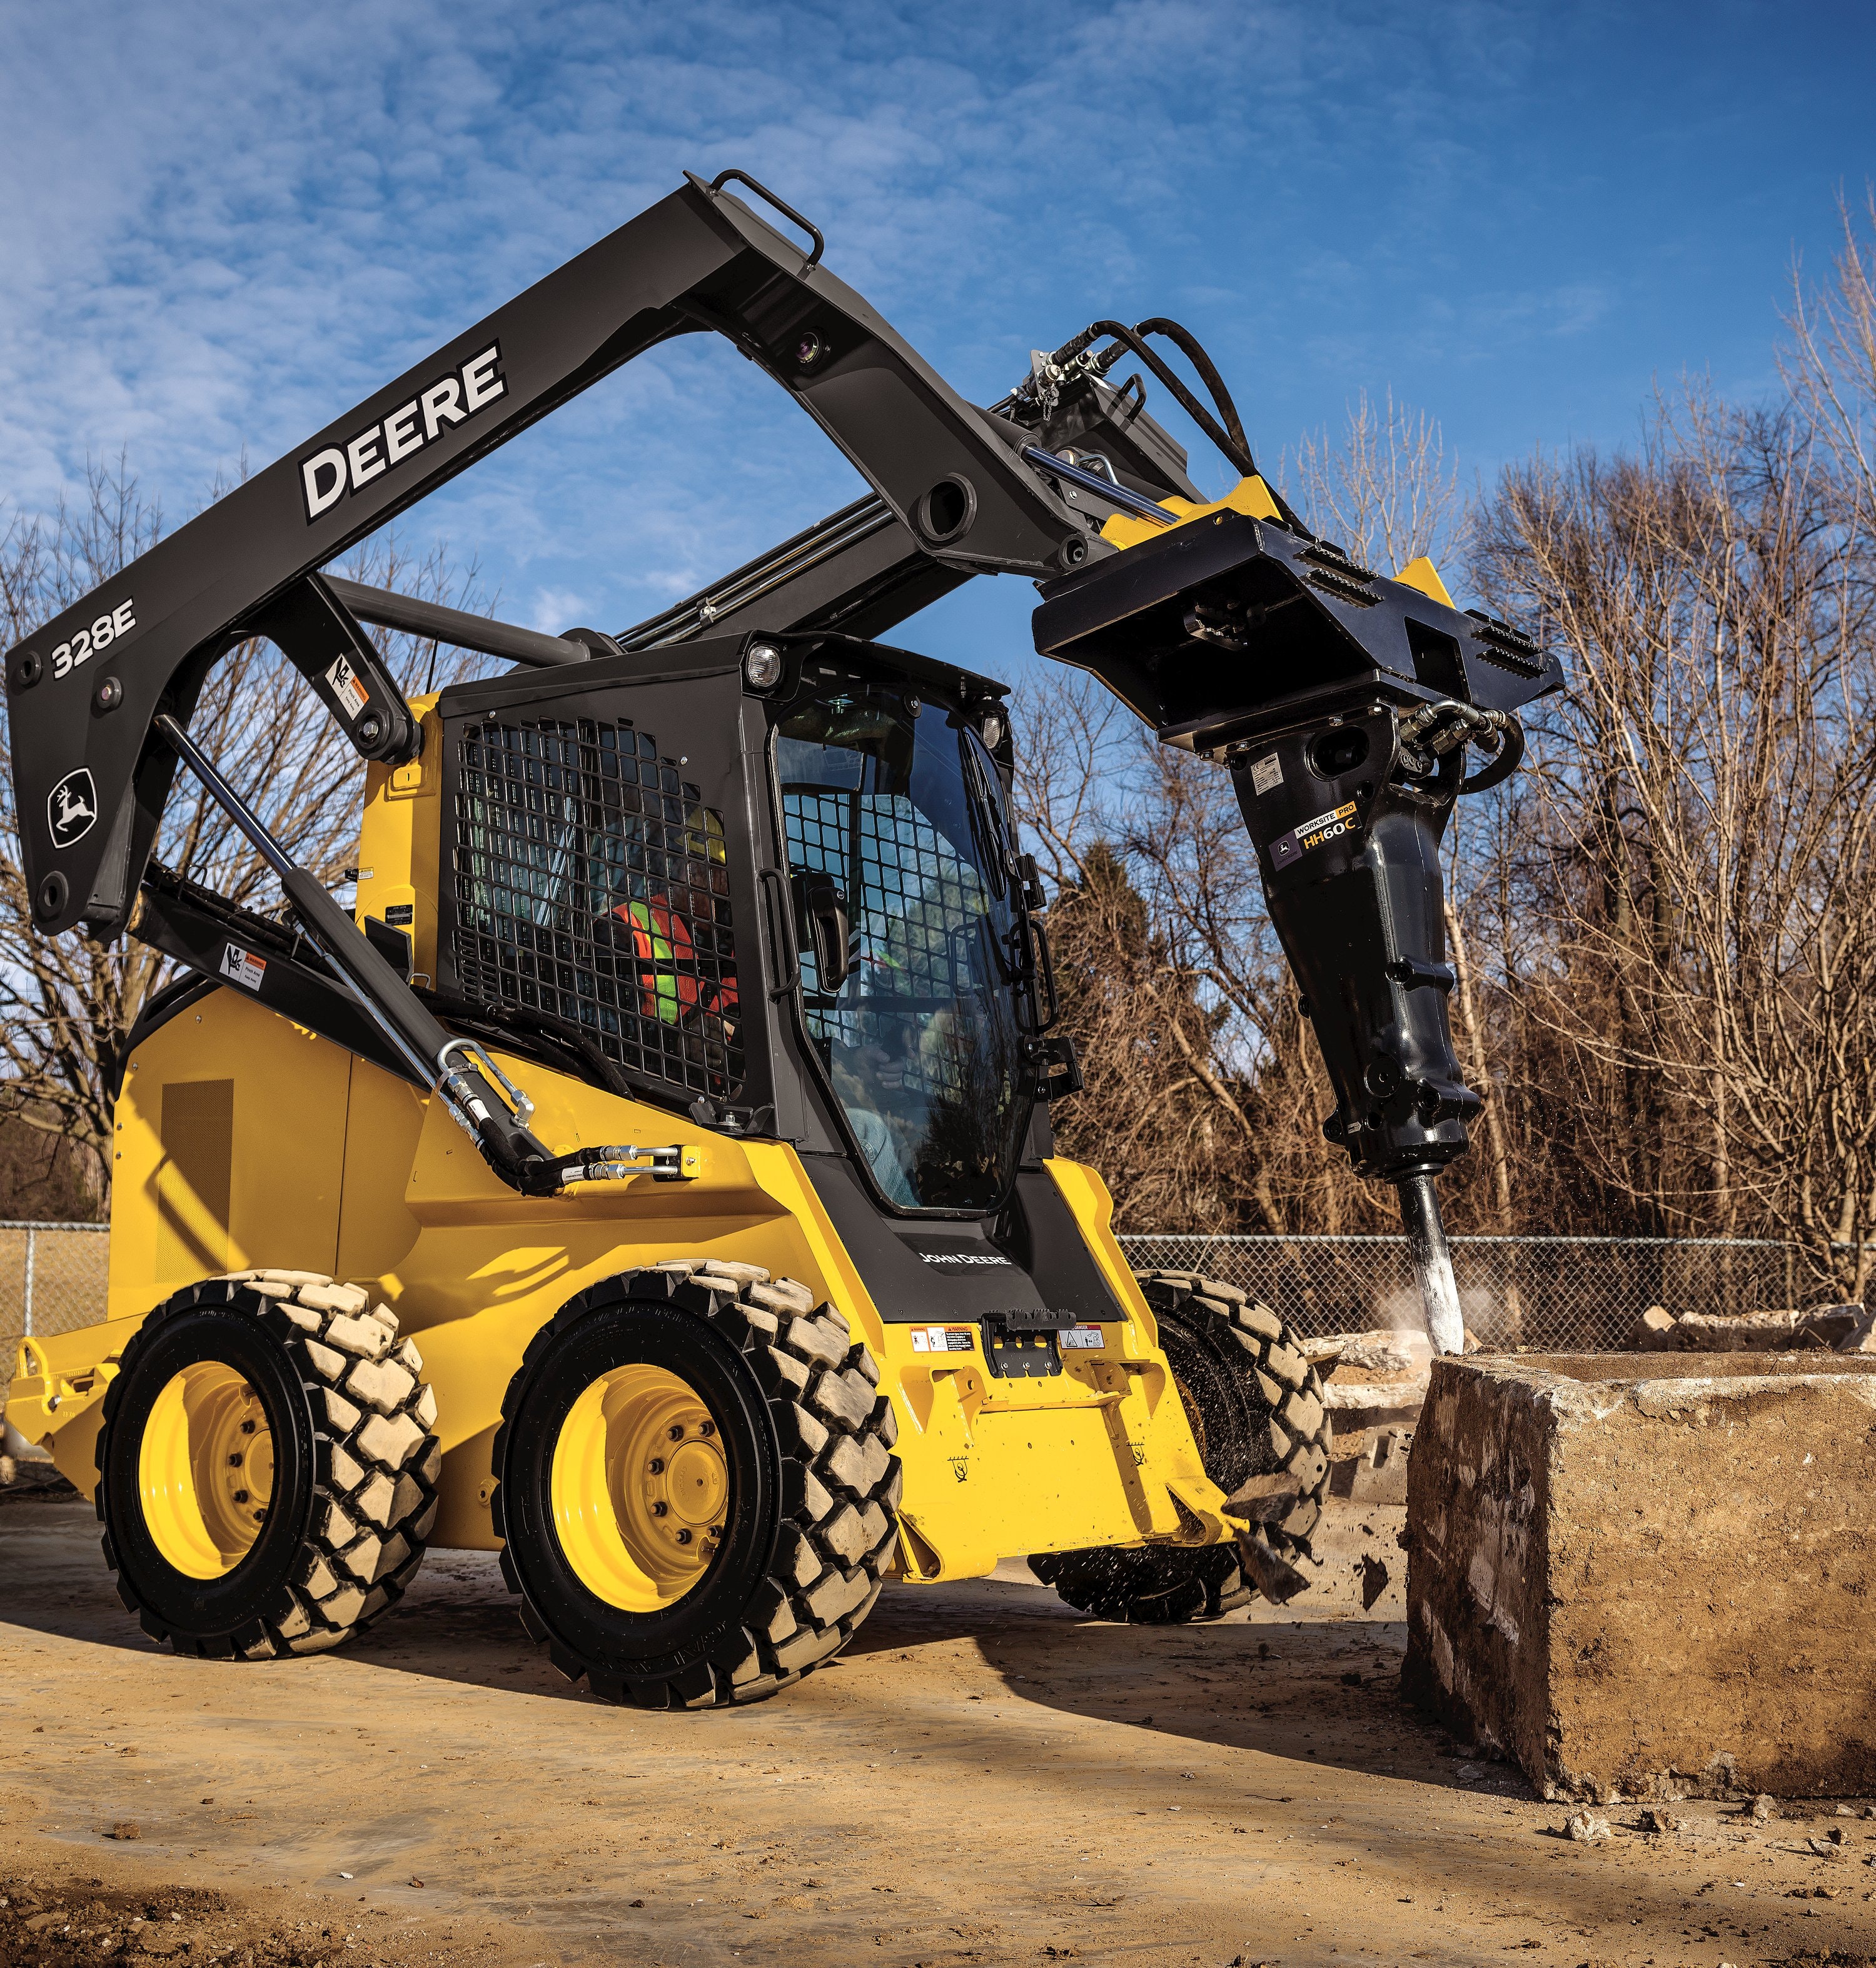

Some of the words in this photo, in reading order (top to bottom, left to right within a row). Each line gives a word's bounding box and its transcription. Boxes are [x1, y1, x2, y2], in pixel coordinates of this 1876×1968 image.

[303, 346, 504, 518] DEERE
[51, 598, 136, 679] 328E
[355, 682, 366, 700] WARNING
[1297, 812, 1336, 835] WORKSITE
[1338, 804, 1354, 815] PRO
[1303, 817, 1356, 849] HH60C
[919, 1253, 963, 1263] JOHN
[956, 1254, 1012, 1265] DEERE
